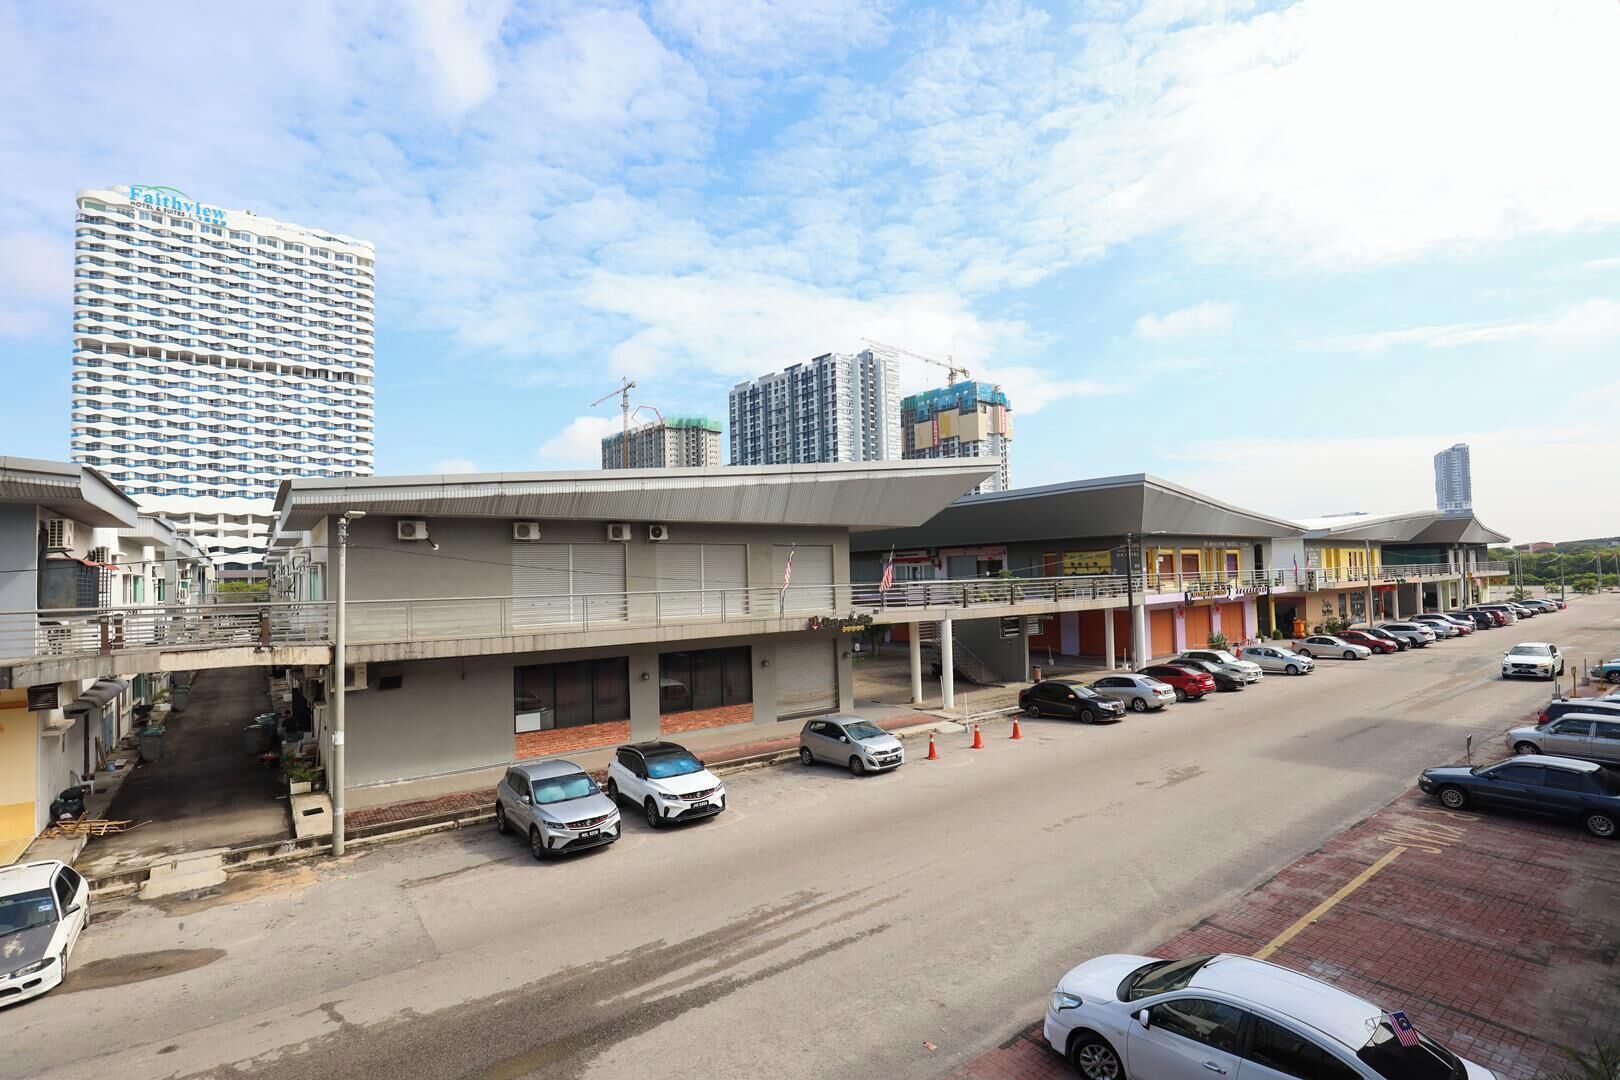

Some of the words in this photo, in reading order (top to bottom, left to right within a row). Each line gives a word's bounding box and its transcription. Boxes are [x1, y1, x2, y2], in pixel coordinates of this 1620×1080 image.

[130, 186, 226, 219] Faithview
[130, 200, 154, 210] HOTEL
[163, 207, 185, 217] SUITES
